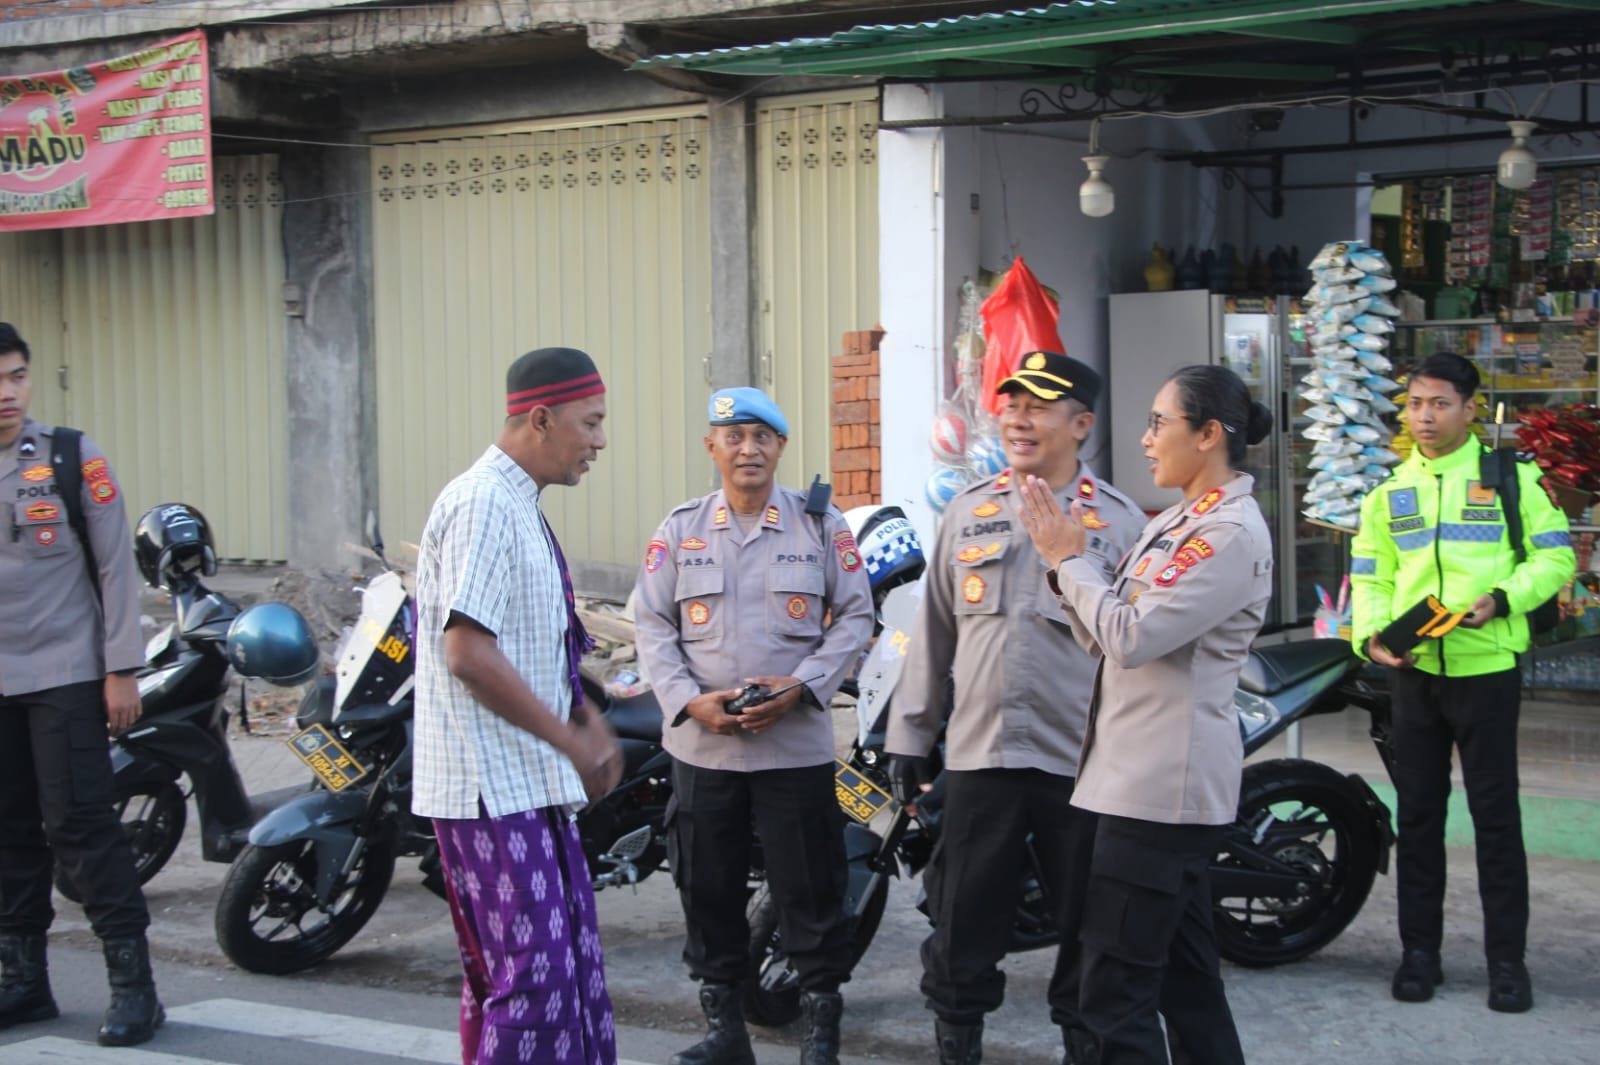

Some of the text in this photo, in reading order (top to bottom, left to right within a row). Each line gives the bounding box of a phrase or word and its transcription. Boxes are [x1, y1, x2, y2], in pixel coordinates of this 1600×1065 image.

[21, 78, 76, 127] BAKAR
[0, 135, 85, 173] MADU
[678, 557, 716, 568] ASA
[777, 554, 819, 564] POLRI
